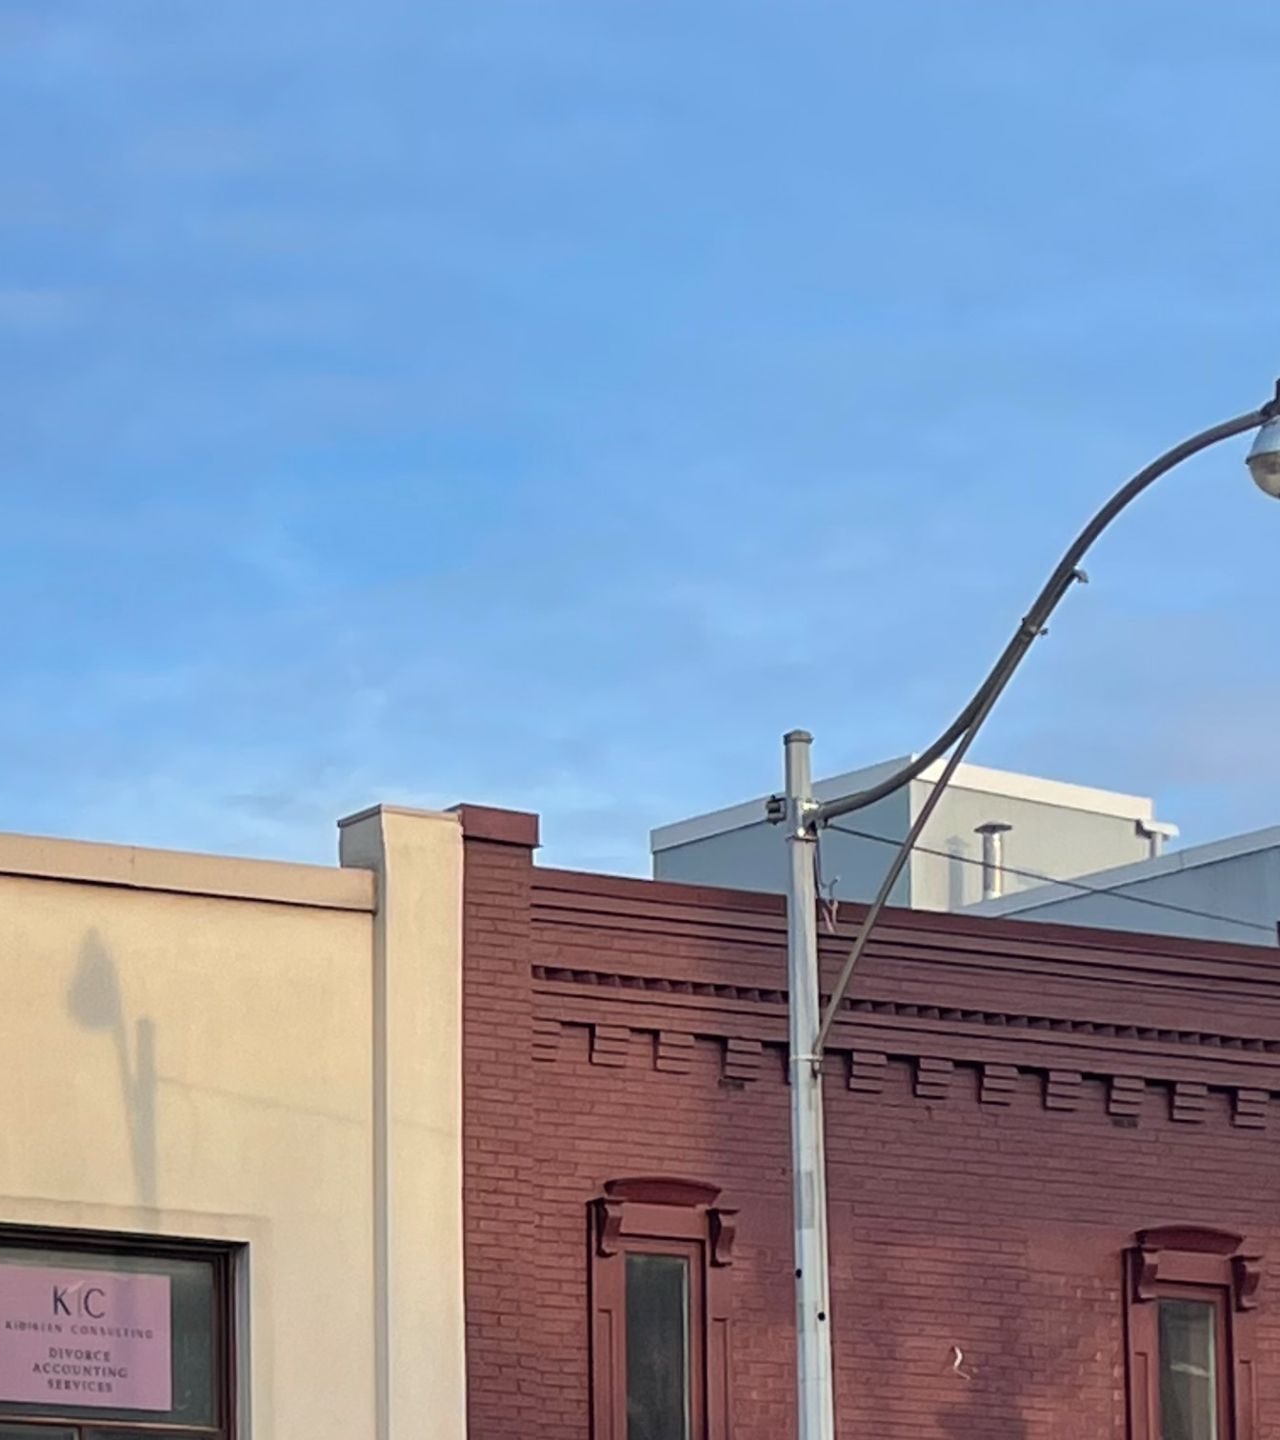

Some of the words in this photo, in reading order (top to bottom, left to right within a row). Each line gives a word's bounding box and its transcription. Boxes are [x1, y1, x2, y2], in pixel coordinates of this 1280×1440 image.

[49, 1347, 111, 1362] DIVORCE
[32, 1362, 128, 1378] ACCOUNTING
[47, 1378, 112, 1393] SERVICES
